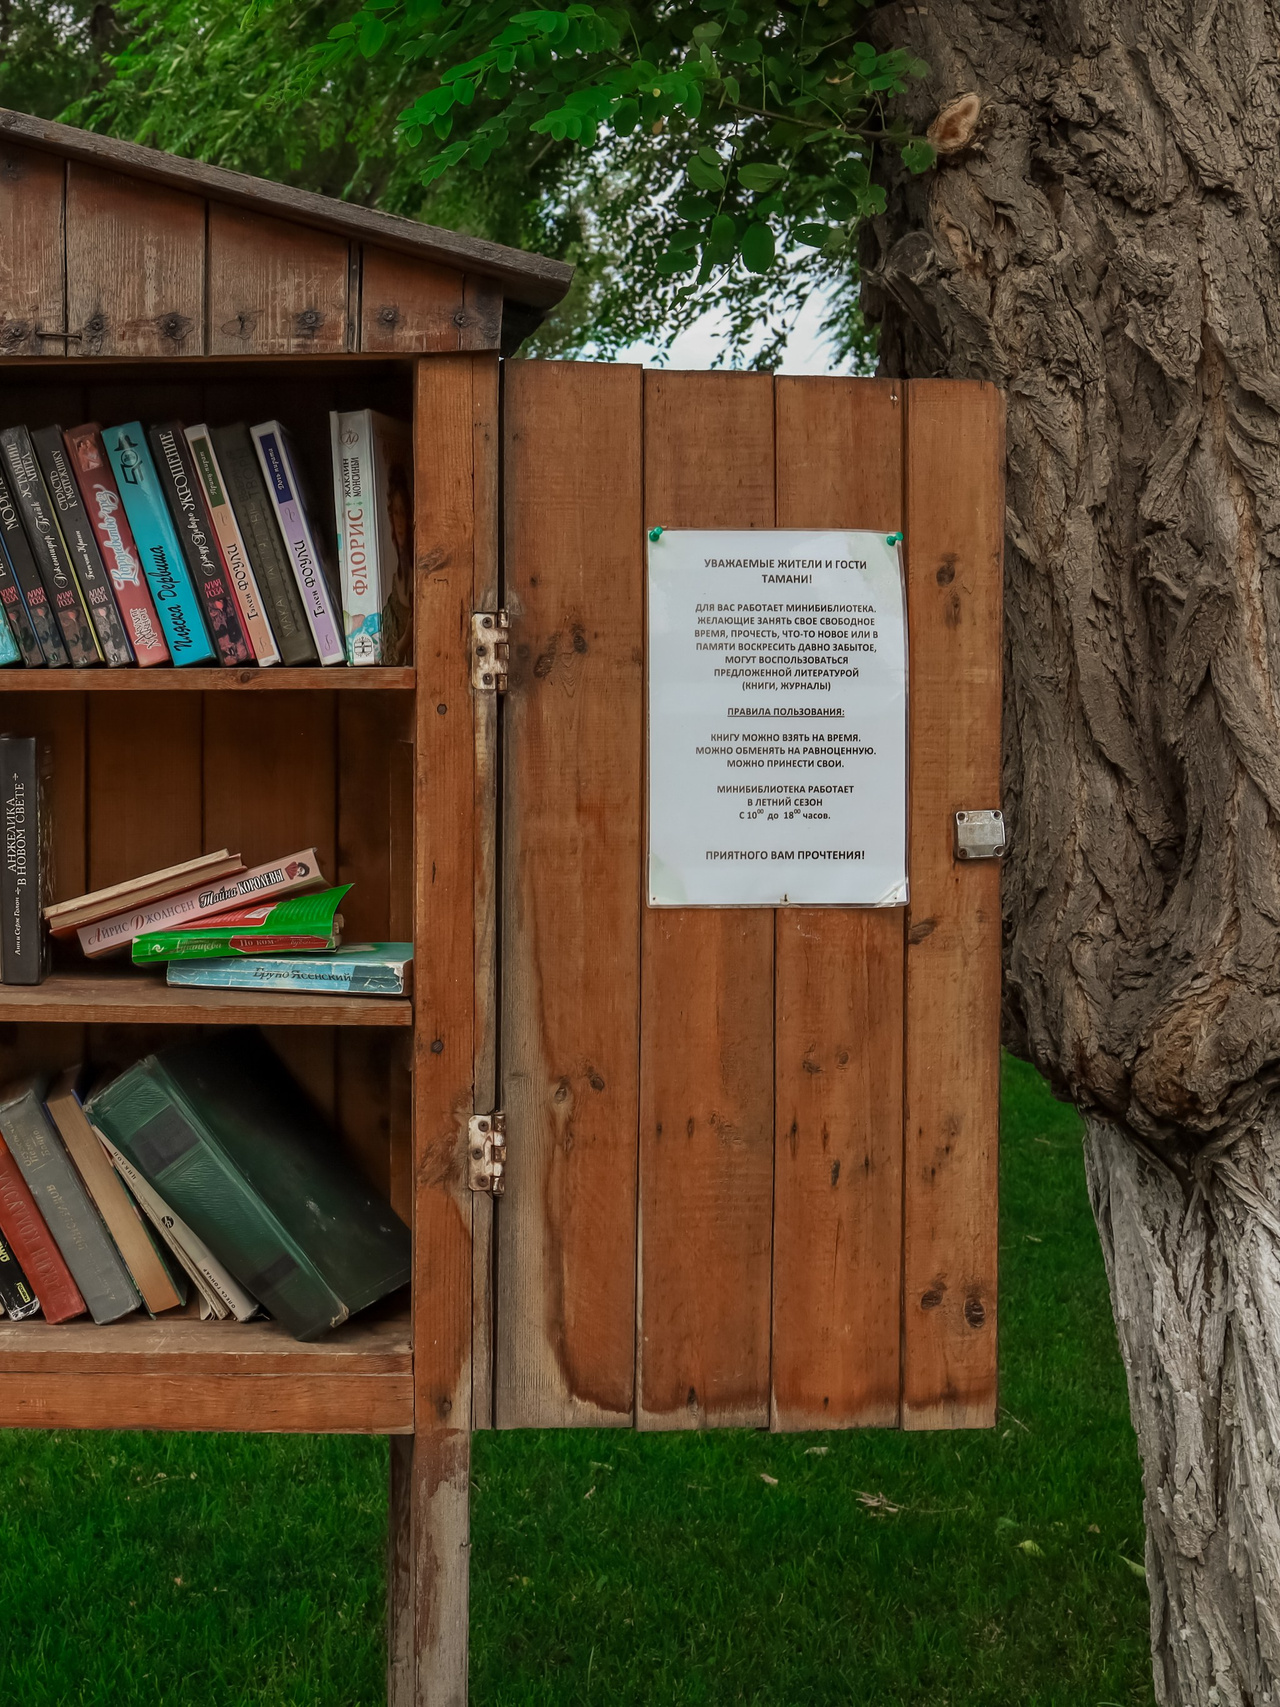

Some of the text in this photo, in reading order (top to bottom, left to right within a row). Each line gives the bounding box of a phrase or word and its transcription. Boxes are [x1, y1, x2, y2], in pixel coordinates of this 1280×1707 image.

[21, 451, 39, 483] АНГЕЛ
[160, 430, 196, 512] УКРОЩЕНИЕ
[341, 457, 353, 497] ЖАКЛИН
[351, 456, 364, 496] МОНСИНЬИ
[49, 470, 70, 511] СТРАСТЬ
[348, 507, 370, 595] ФЛОРИС
[226, 543, 251, 592] ФОУЛИ
[703, 559, 867, 569] УВАЖАЕМЫЕ ЖИТЕЛИ И ГОСТИ
[293, 539, 326, 618] Гэлен ФОУЛИ
[761, 574, 813, 583] ТАМАНИ!
[146, 544, 194, 652] Пляска Дервиша
[694, 604, 715, 612] ДЛЯ
[737, 604, 784, 612] РАБОТАЕТ
[785, 604, 877, 612] МИНИБИБЛИОТЕКА.
[697, 617, 875, 627] ЖЕЛАЮЩИЕ ЗАНЯТЬ СВОЕ СВОБОДНОЕ
[694, 630, 729, 638] ВРЕМЯ,
[730, 630, 780, 639] ПРОЧЕСТЬ,
[781, 630, 816, 638] ЧТО-ТО
[817, 630, 849, 638] НОВОЕ
[737, 643, 797, 651] ВОСКРЕСИТЬ
[797, 643, 831, 652] ДАВНО
[832, 644, 877, 653] ЗАБЫТОЕ,
[724, 656, 849, 664] МОГУТ ВОСПОЛЬЗОВАТЬСЯ
[713, 667, 859, 678] ПРЕДЛОЖЕННОЙ ЛИТЕРАТУРОЙ
[741, 682, 831, 692] (КНИГИ, ЖУРНАЛЫ)
[727, 708, 845, 716] ПРАВИЛА ПОЛЬЗОВАНИЯ:
[741, 734, 781, 742] МОЖНО
[781, 734, 811, 742] ВЗЯТЬ
[811, 734, 826, 742] НА
[827, 734, 861, 742] ВРЕМЯ.
[802, 747, 877, 756] РАВНОЦЕННУЮ.
[816, 760, 845, 768] СВОИ.
[15, 783, 26, 822] СВЕТЕ
[754, 797, 792, 806] ЛЕТНИЙ
[793, 798, 823, 806] СЕЗОН
[6, 797, 17, 872] АНЖЕЛИКА
[16, 828, 26, 874] НОВОМ
[705, 850, 865, 860] ПРИЯТНОГО ВАМ ПРОЧТЕНИЯ!
[196, 868, 285, 908] Тайна КОРОЛЕВЫ
[85, 896, 196, 946] АЙРИС ДЖОАНСЕН
[203, 1267, 237, 1309] ОЛЕСЬ ГОНЧАР
